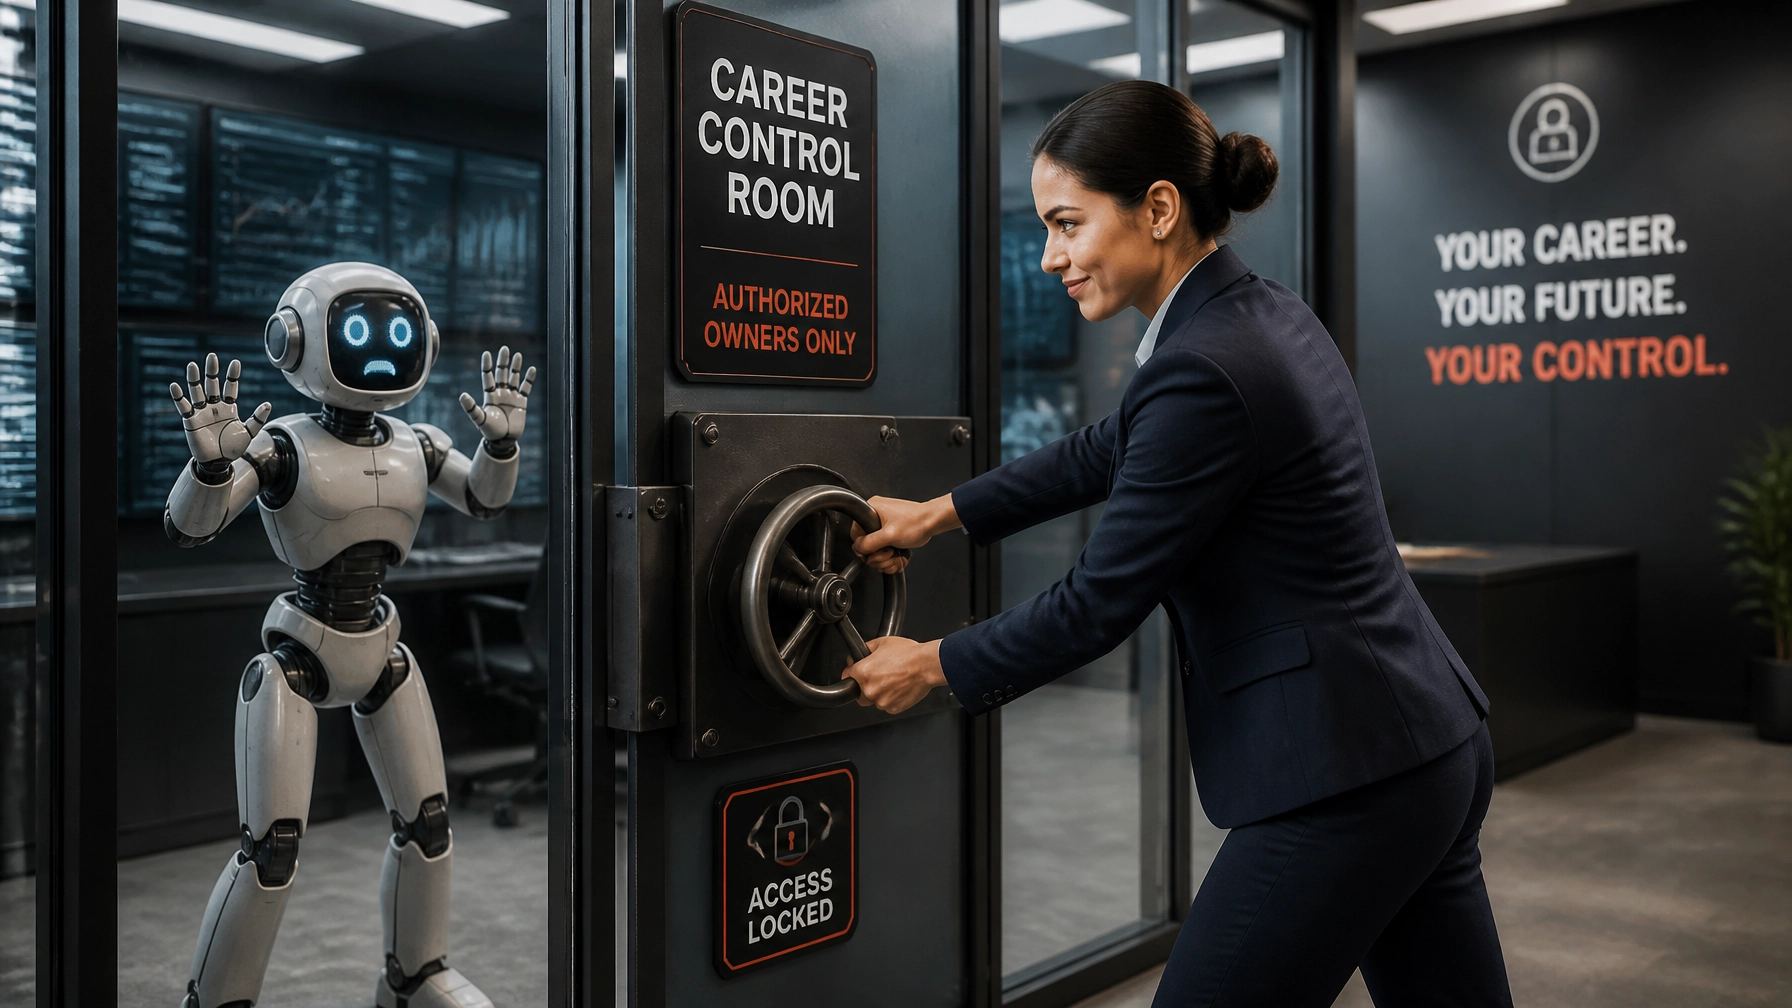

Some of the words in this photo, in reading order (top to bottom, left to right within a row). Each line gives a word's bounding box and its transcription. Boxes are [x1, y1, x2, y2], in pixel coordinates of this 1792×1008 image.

[710, 57, 848, 129] CAREER
[698, 110, 860, 181] CONTROL
[728, 171, 834, 228] ROOM
[1434, 228, 1526, 272] YOUR
[1533, 213, 1688, 265] CAREER.
[712, 283, 849, 320] AUTHORIZED
[1434, 284, 1526, 328] YOUR
[1534, 273, 1688, 322] FUTURE.
[704, 321, 800, 352] OWNERS
[806, 328, 857, 355] ONLY
[1425, 343, 1522, 386] YOUR
[1532, 334, 1729, 382] CONTROL.
[747, 868, 833, 914] ACCESS
[748, 898, 834, 944] LOCKED
